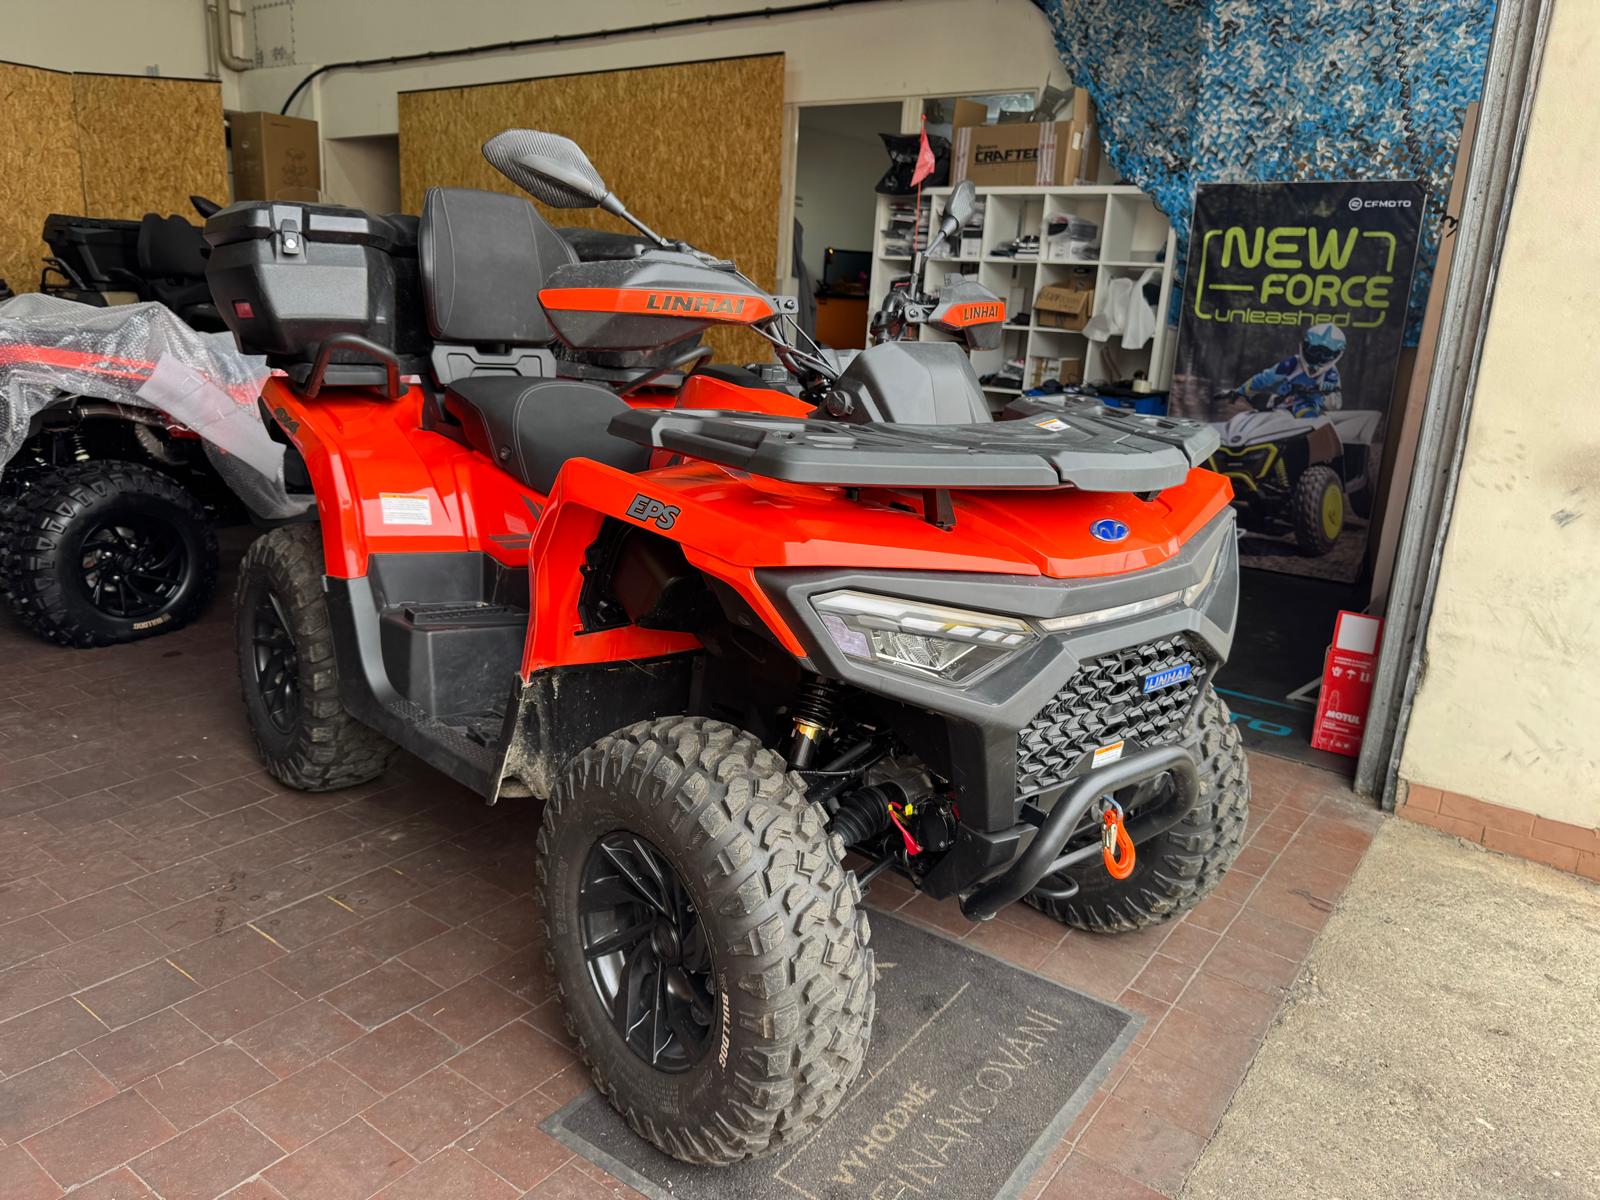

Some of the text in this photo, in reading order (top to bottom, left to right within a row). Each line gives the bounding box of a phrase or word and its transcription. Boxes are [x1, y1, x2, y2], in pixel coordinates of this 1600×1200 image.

[1364, 200, 1412, 208] CFMOTO
[1221, 226, 1359, 270] NEW
[1260, 273, 1394, 308] FORCE
[646, 294, 745, 315] LINHAI
[963, 305, 999, 321] LINHAI
[1214, 308, 1350, 327] unleashed
[625, 492, 682, 531] EPS
[1147, 667, 1189, 688] LINHAI
[1325, 710, 1361, 724] MOTUL
[718, 991, 731, 1069] BULLDOG
